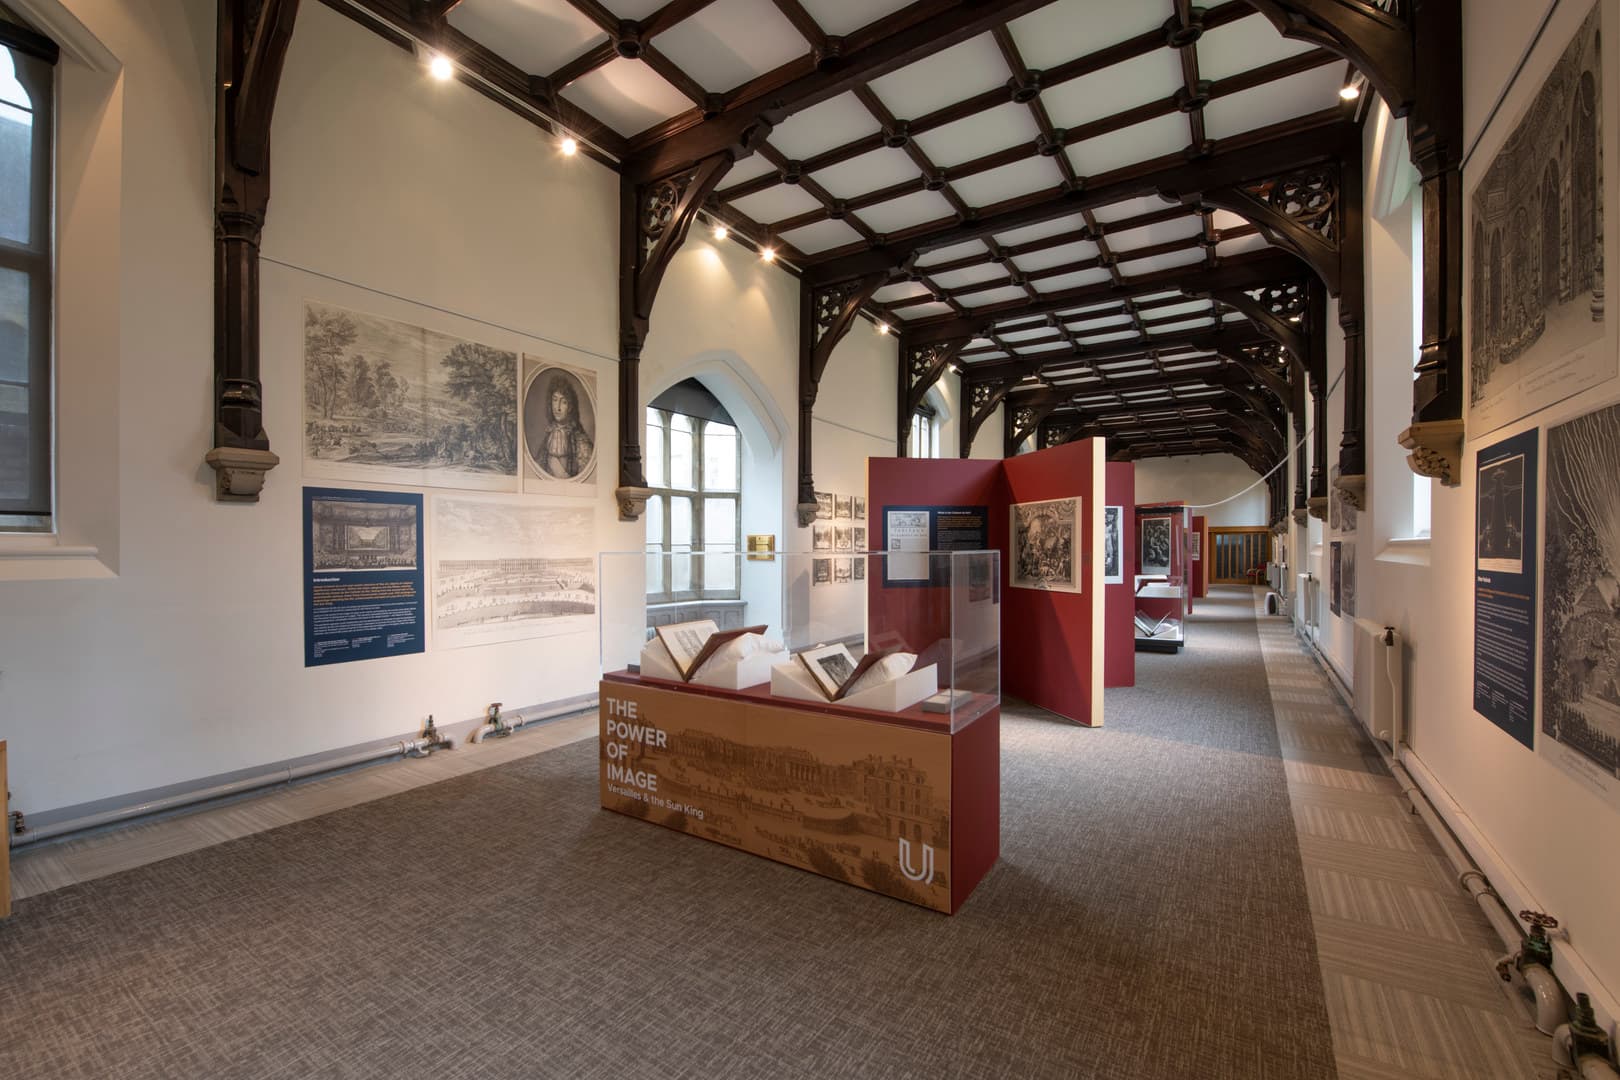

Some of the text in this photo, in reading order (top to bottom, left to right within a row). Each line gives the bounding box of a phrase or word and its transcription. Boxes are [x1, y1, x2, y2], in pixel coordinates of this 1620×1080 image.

[606, 697, 638, 719] THE
[606, 719, 667, 748] POWER
[606, 742, 628, 760] OF
[607, 763, 657, 792] IMAGE
[607, 782, 704, 820] Versailles & the Sun King
